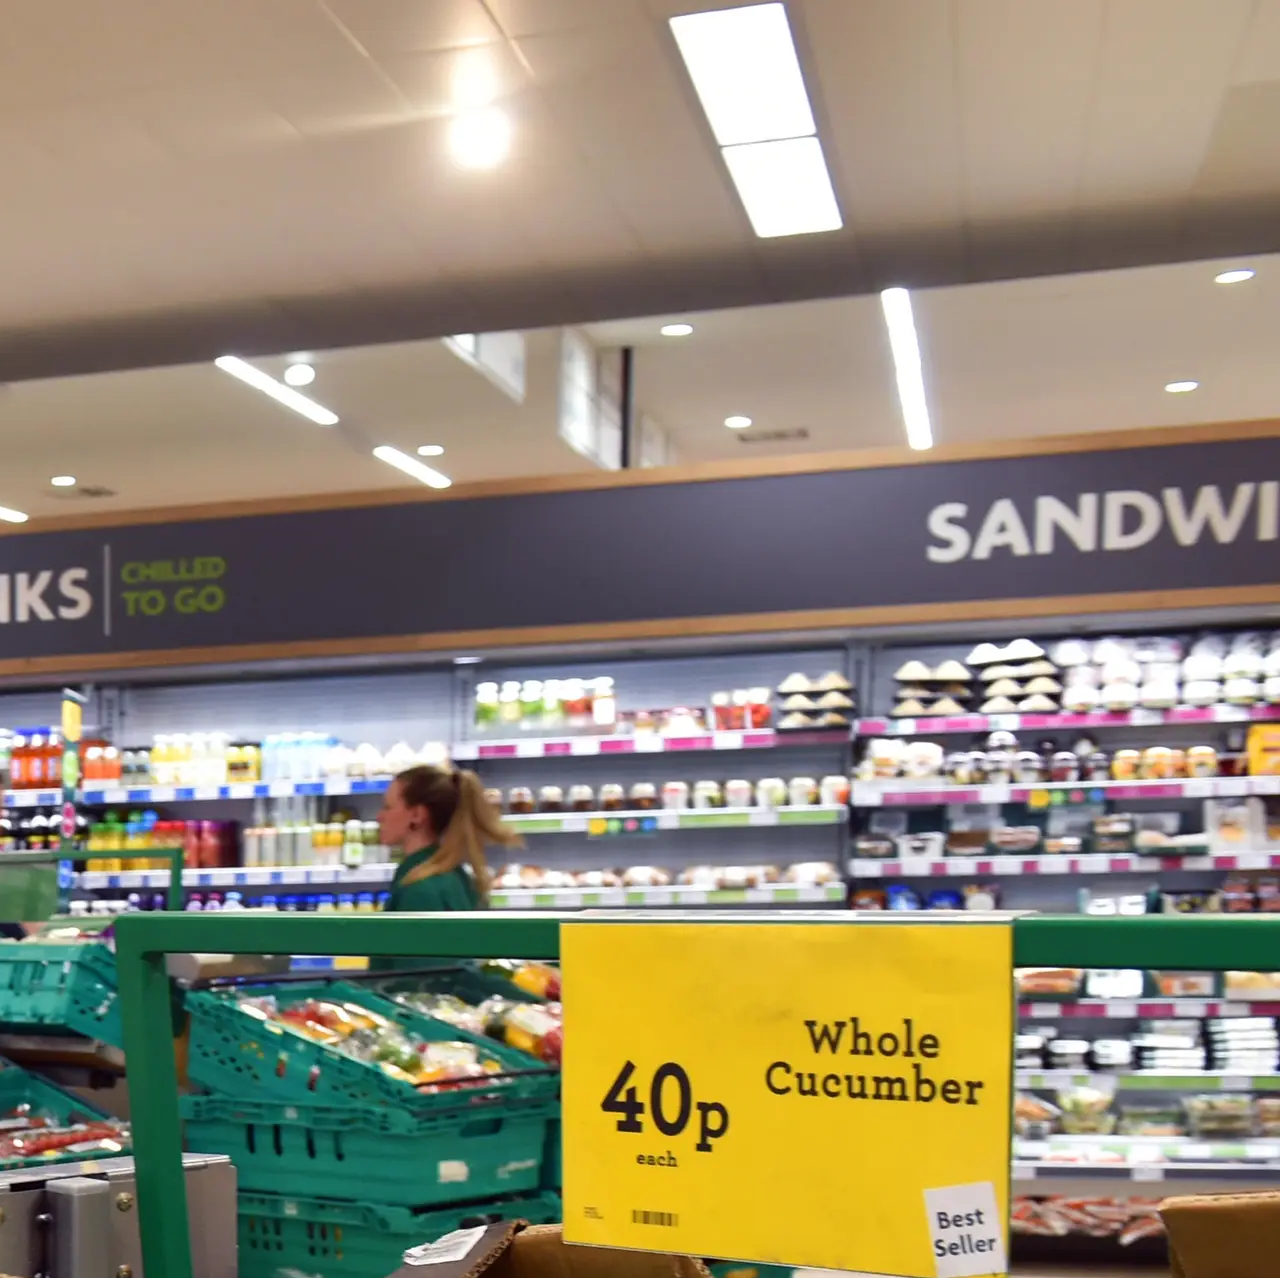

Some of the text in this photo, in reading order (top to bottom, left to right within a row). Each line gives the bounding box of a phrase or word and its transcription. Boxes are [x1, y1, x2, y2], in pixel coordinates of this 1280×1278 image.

[926, 480, 1279, 563] SANDWI
[121, 556, 226, 584] CHILLED
[120, 585, 226, 617] TO GO
[804, 1016, 941, 1060] Whole
[765, 1061, 986, 1107] Cucumber
[600, 1058, 730, 1153] 40p
[636, 1151, 679, 1169] each
[936, 1209, 986, 1231] Best
[933, 1234, 998, 1259] Seller
